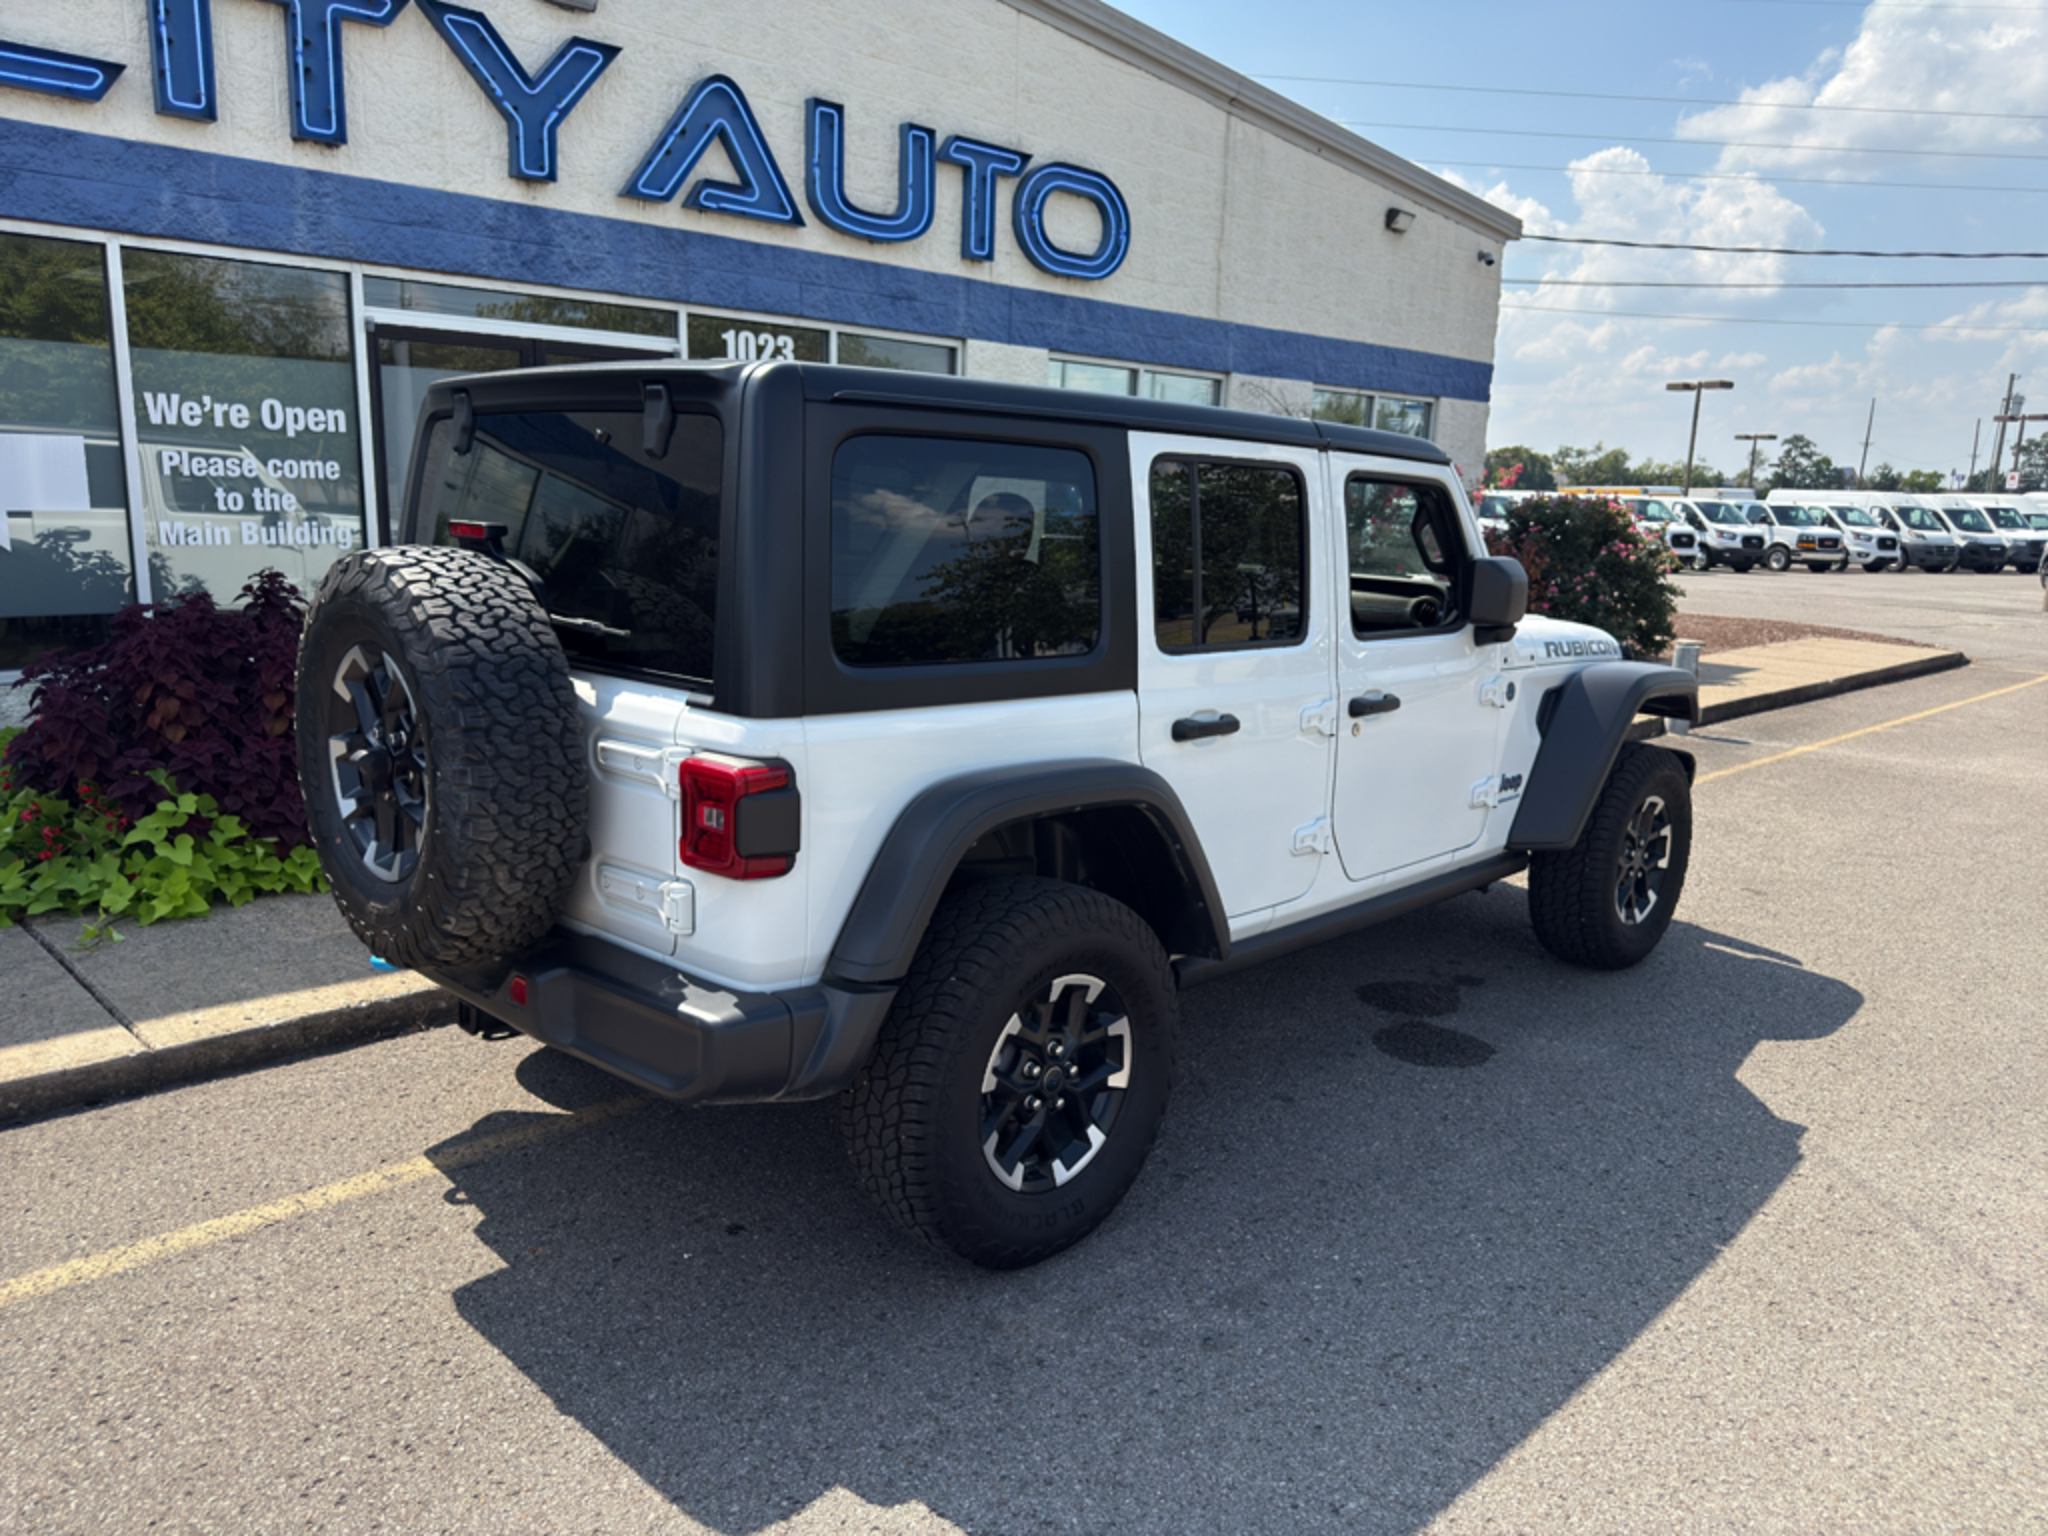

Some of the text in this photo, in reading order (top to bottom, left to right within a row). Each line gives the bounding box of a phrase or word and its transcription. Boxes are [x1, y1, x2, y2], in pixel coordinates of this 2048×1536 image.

[0, 0, 1131, 281] ITY AUTO
[721, 329, 795, 360] 1023
[143, 391, 348, 437] We're Open
[161, 450, 341, 480] Please come
[214, 487, 297, 513] to the
[158, 521, 353, 550] Main Building
[1544, 640, 1619, 658] RUBICON
[1498, 773, 1523, 793] Jeep
